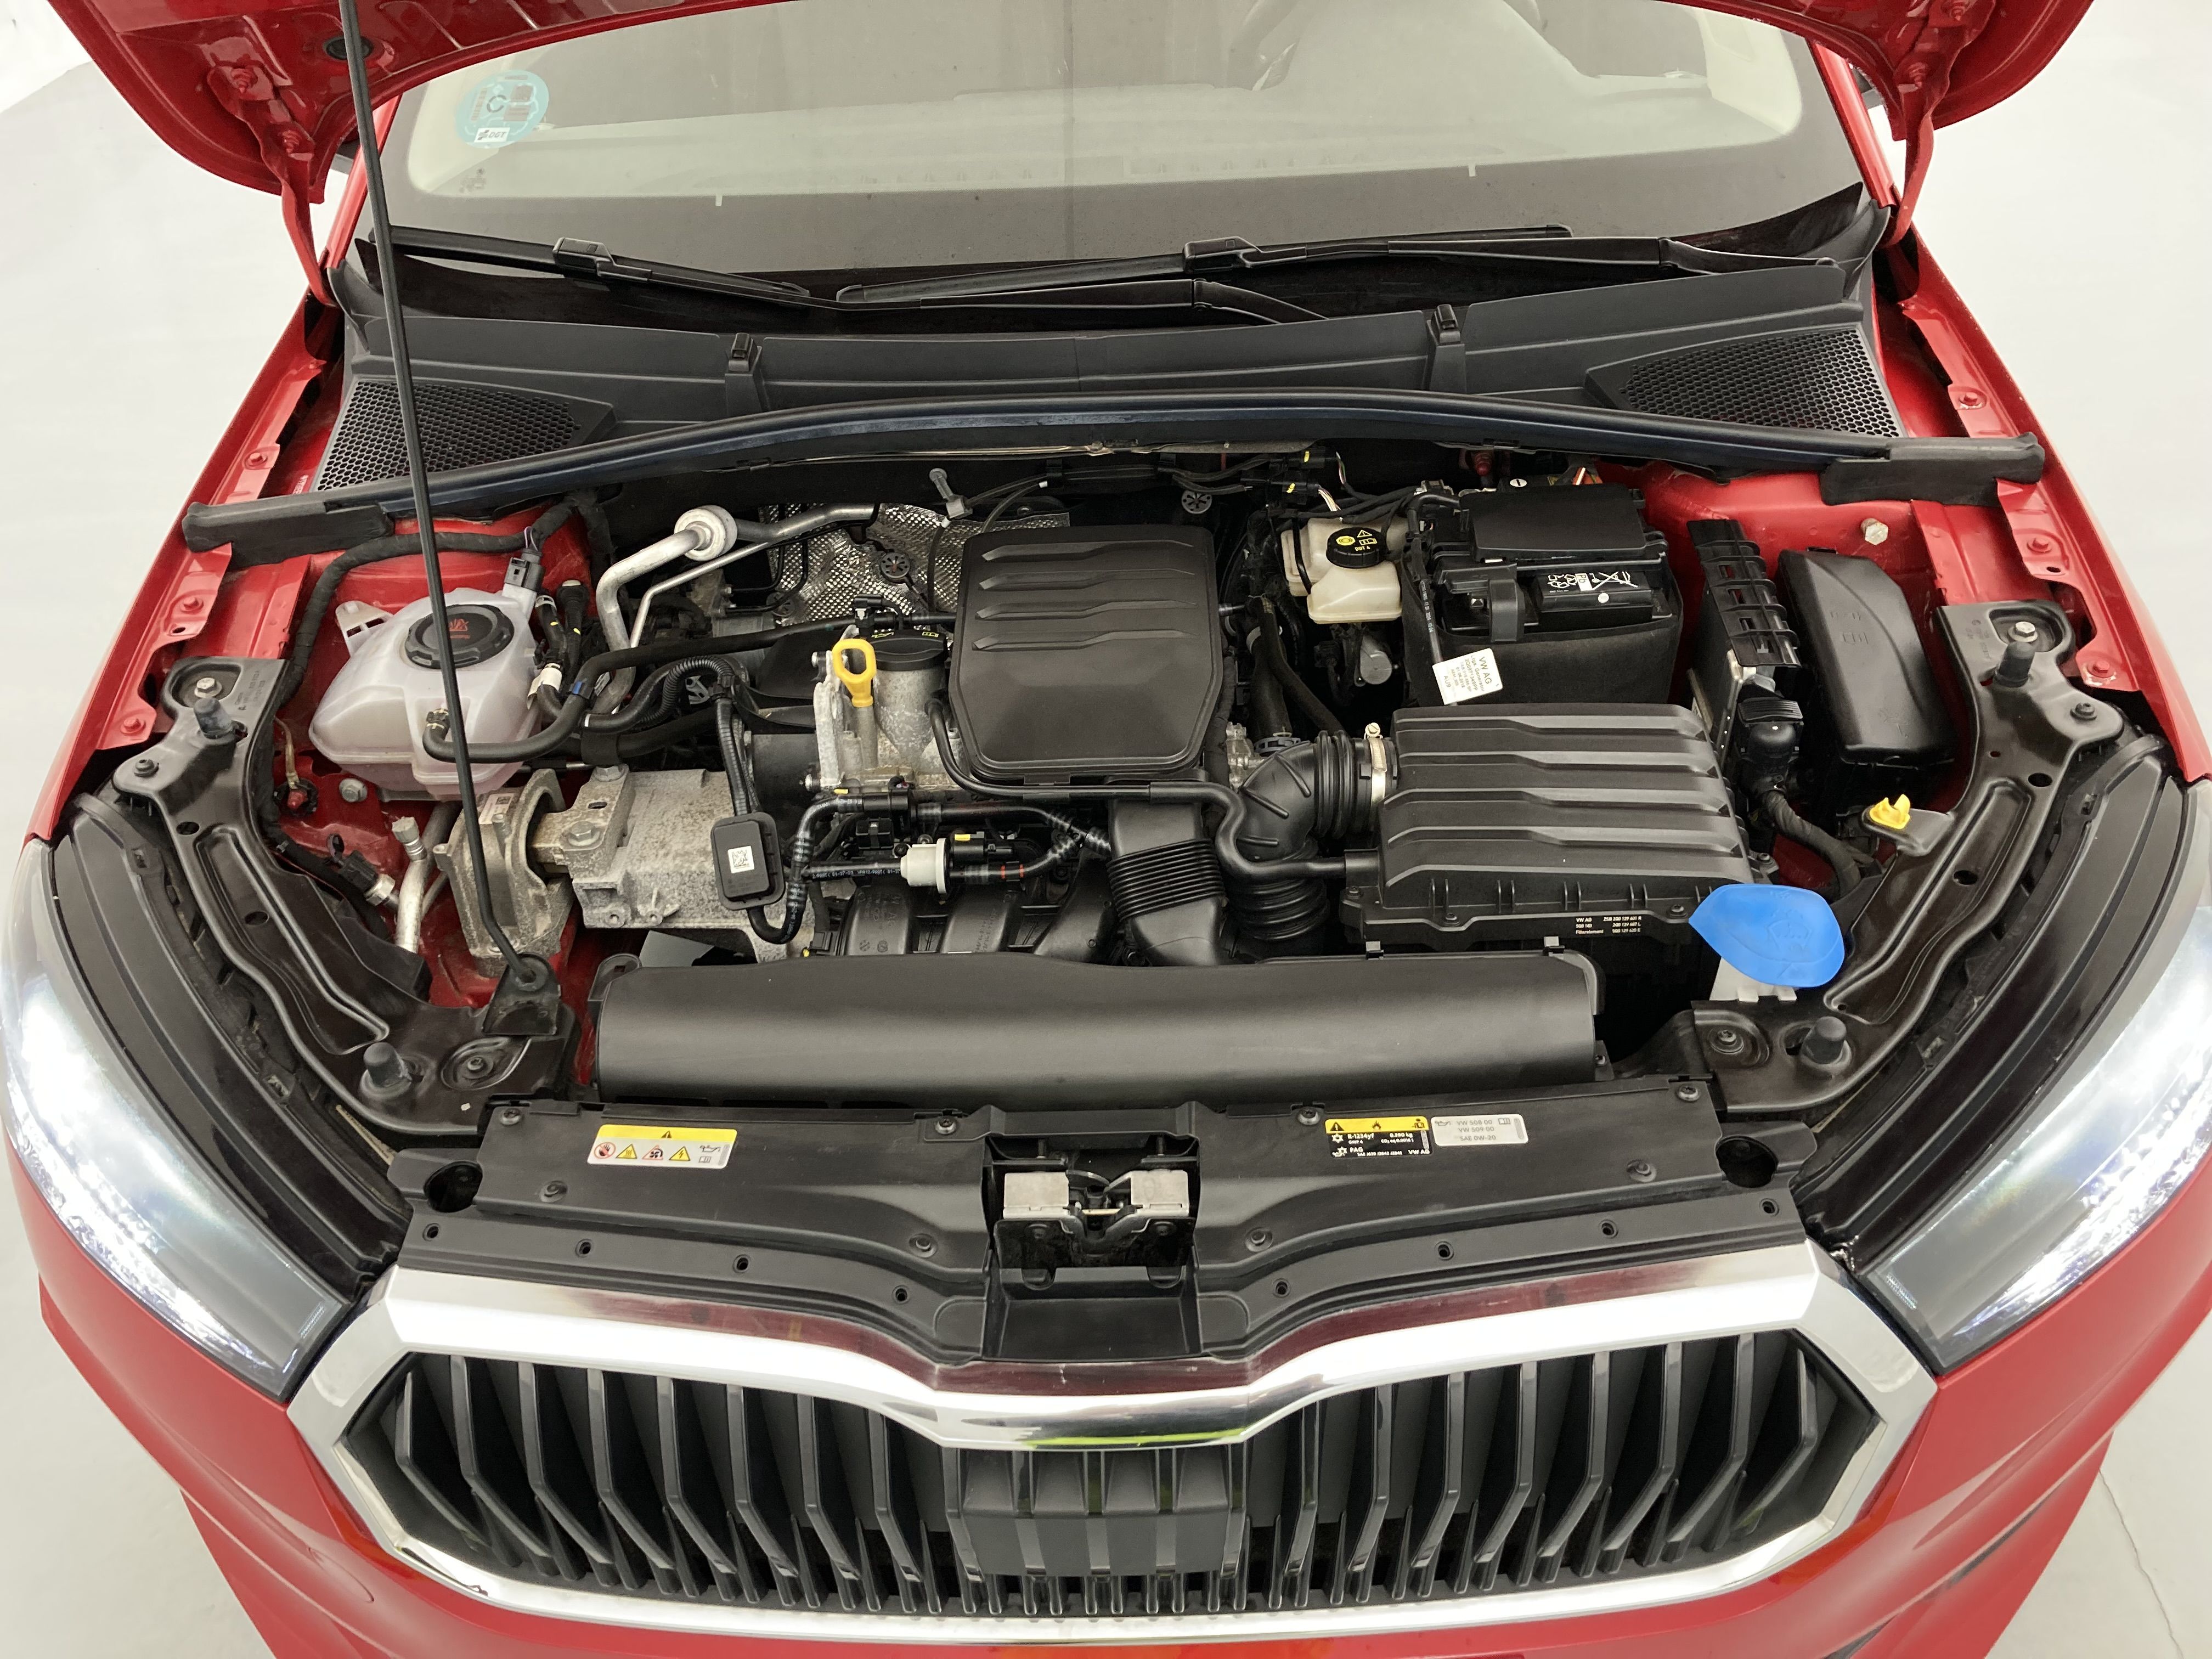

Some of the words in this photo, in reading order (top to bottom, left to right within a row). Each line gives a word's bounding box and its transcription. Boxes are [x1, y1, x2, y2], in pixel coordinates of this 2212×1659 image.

[1479, 657, 1488, 670] VW
[1475, 668, 1485, 692] Generator
[1483, 672, 1492, 684] AG
